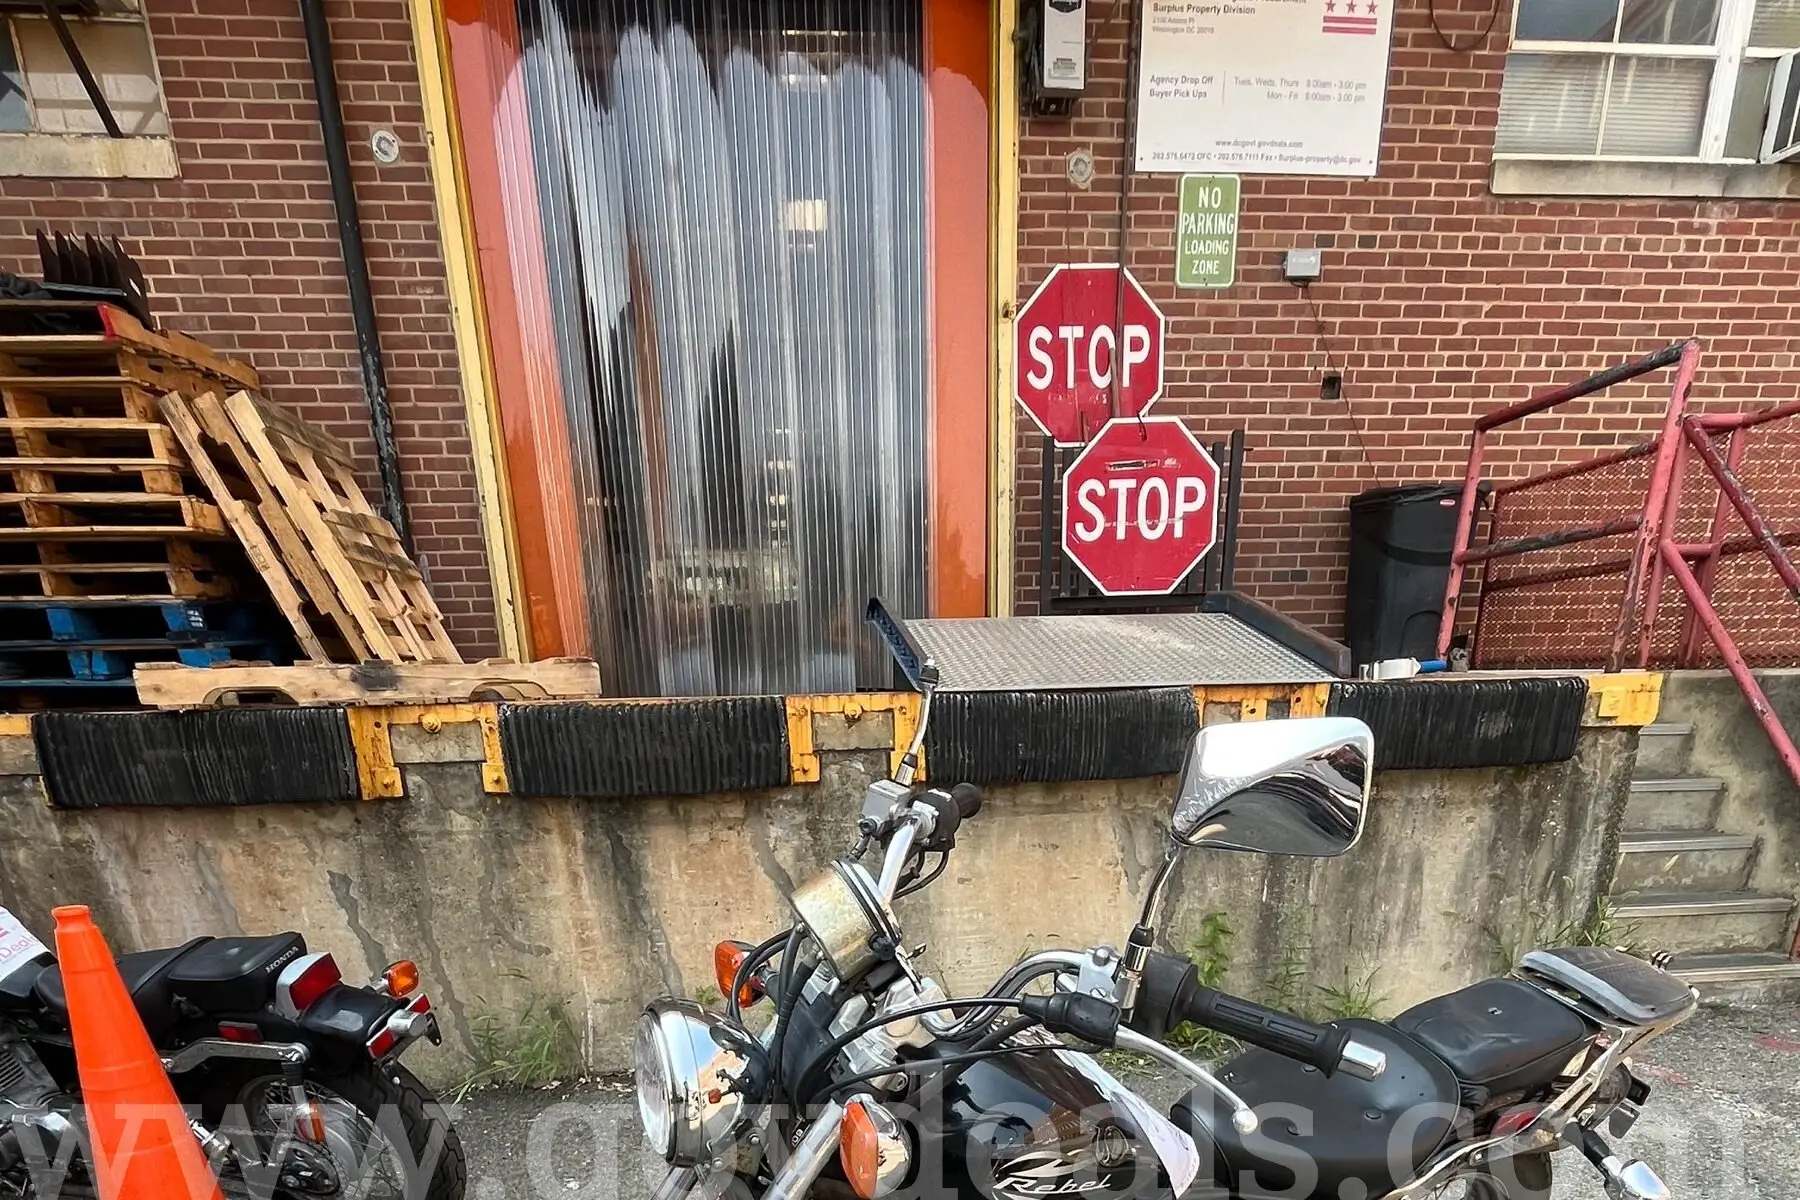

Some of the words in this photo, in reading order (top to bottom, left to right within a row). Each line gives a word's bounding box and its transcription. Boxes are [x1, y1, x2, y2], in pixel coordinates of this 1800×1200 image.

[1153, 3, 1184, 13] Surplus
[1187, 4, 1221, 15] Property
[1223, 4, 1256, 14] Division
[1150, 74, 1179, 86] Agency
[1181, 75, 1200, 85] Drop
[1201, 75, 1214, 84] Off
[1149, 88, 1172, 99] Buyer
[1174, 88, 1190, 97] Pick
[1192, 89, 1207, 100] Ups
[1261, 153, 1272, 161] Fax
[1198, 186, 1222, 208] NO
[1181, 212, 1235, 235] PARKING
[1185, 240, 1229, 255] LOADING
[1192, 260, 1220, 275] ZONE
[1026, 324, 1151, 390] STOP
[1074, 477, 1207, 542] STOP
[265, 946, 299, 973] HONDA
[992, 1174, 1112, 1195] Rebel
